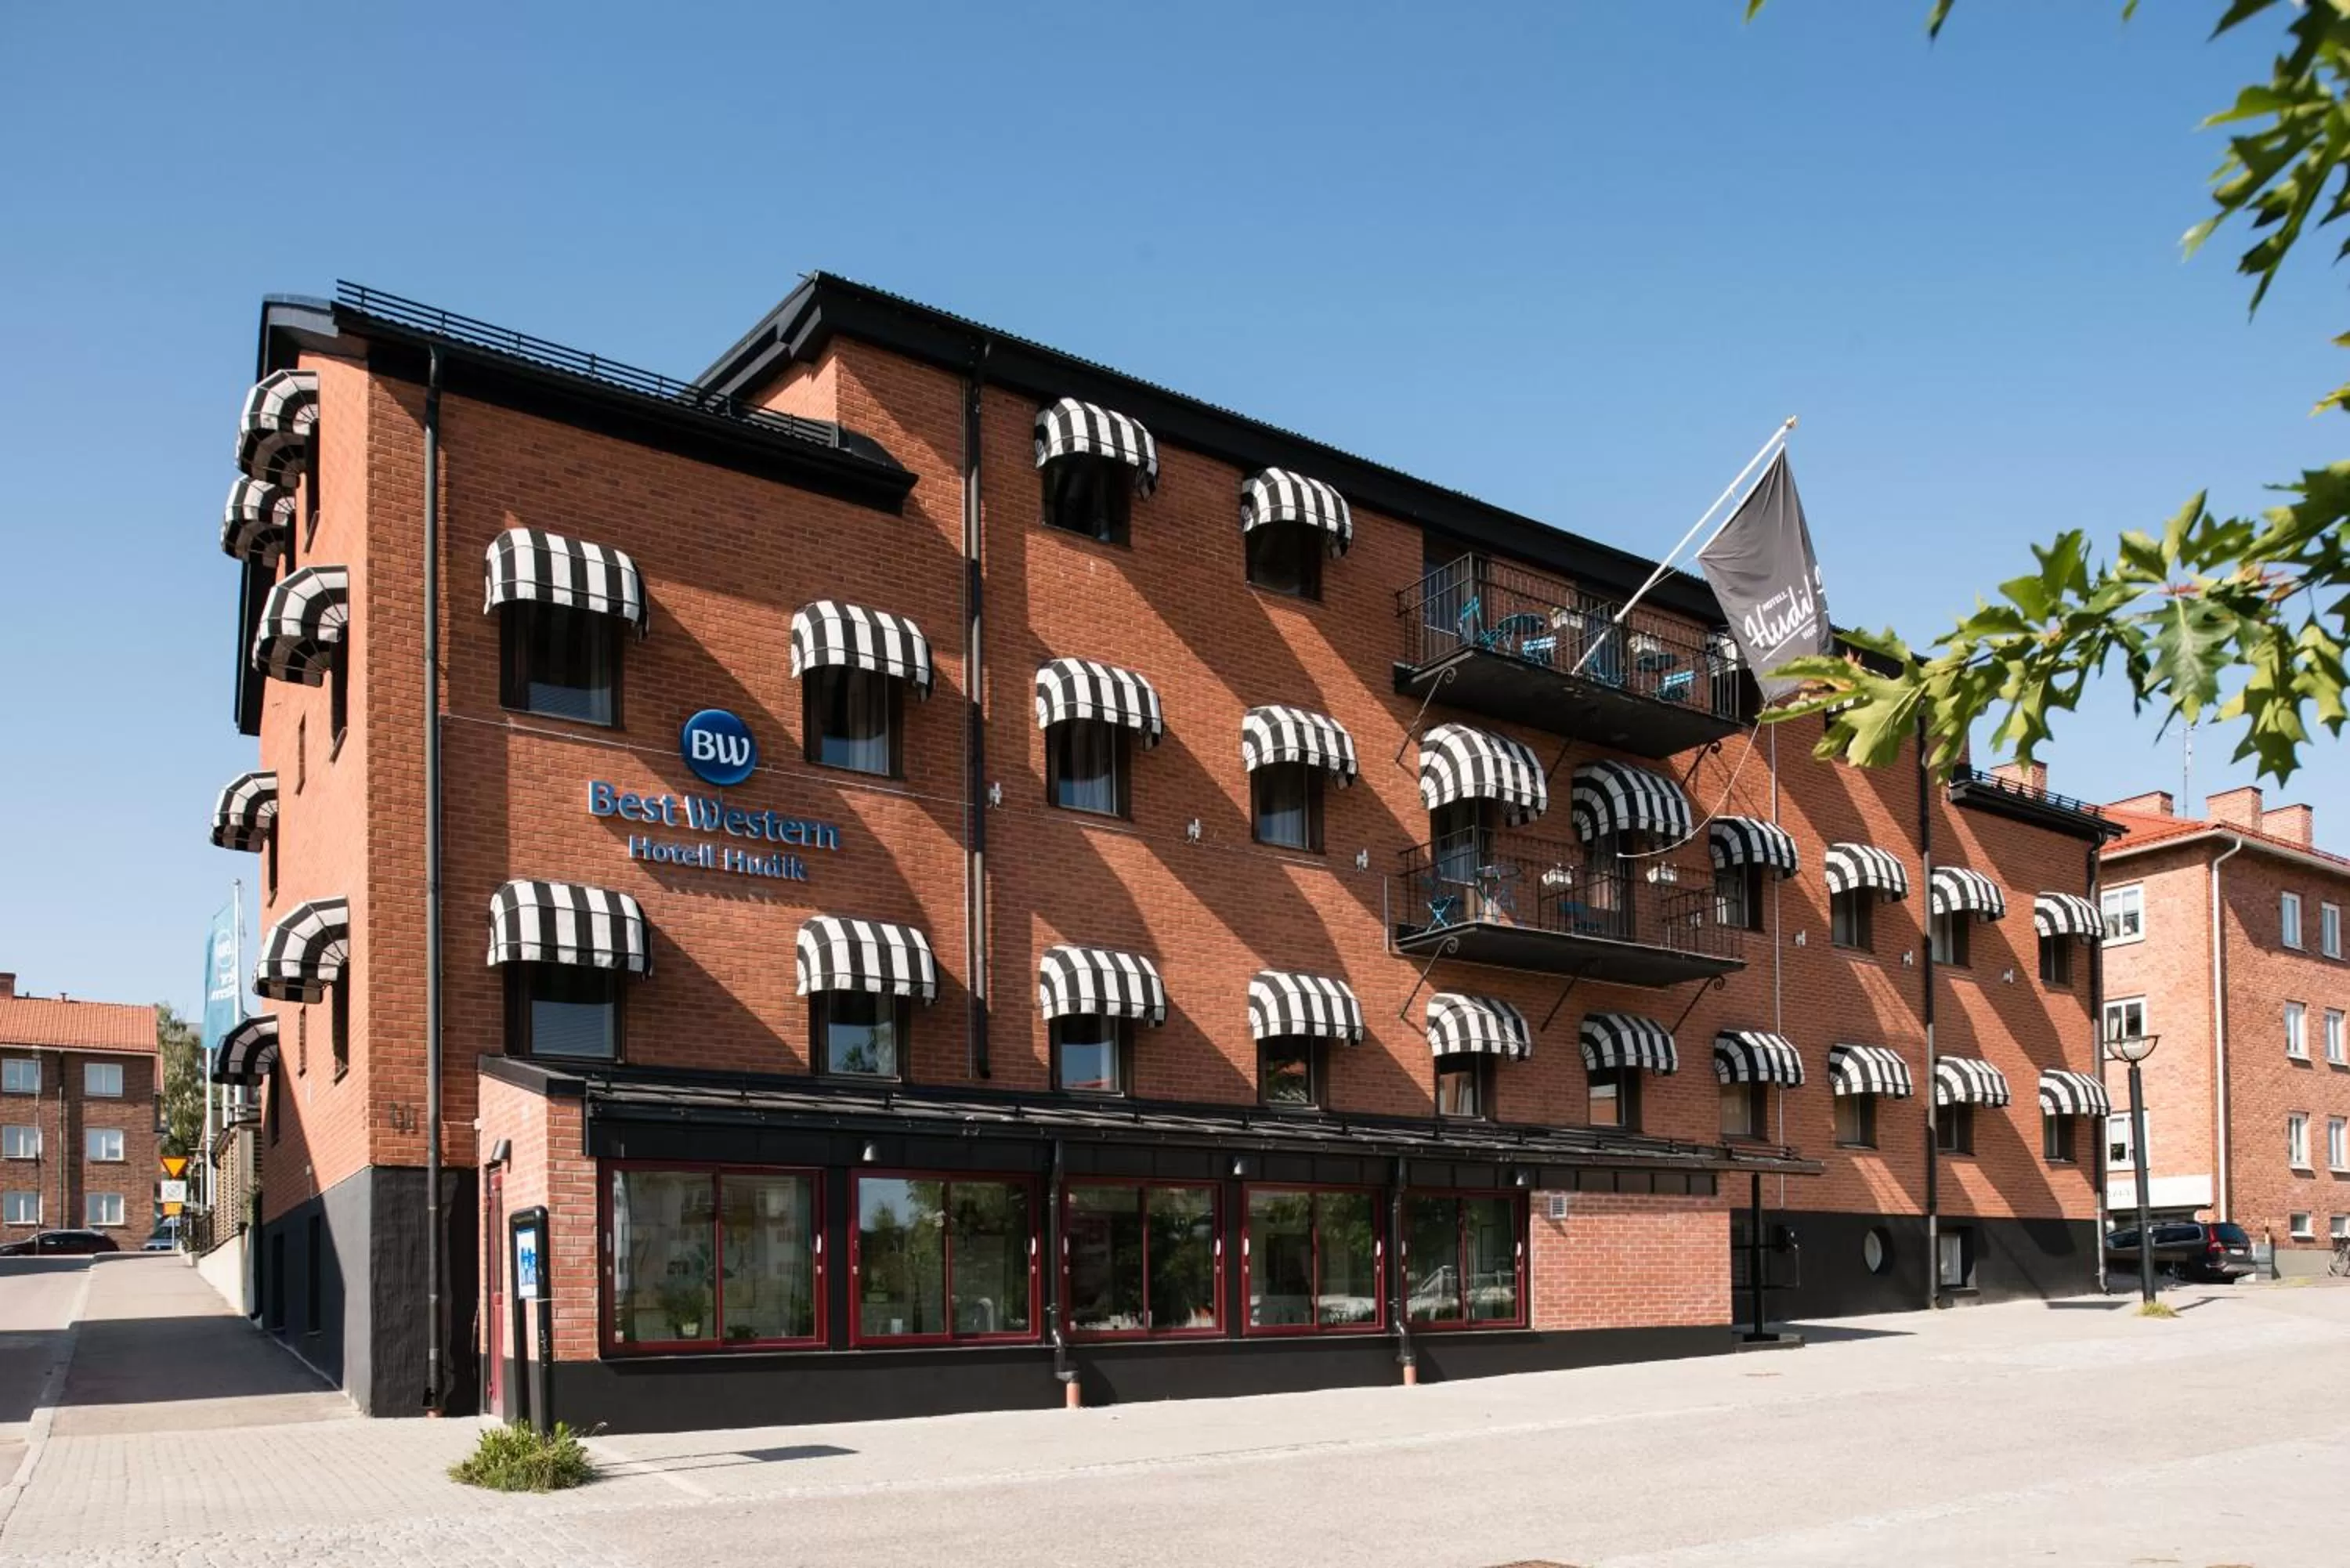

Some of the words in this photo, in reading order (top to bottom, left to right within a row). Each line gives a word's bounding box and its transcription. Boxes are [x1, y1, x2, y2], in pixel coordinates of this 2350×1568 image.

[691, 728, 750, 768] BW
[588, 780, 678, 827] Best
[684, 794, 841, 851] Western
[629, 834, 716, 869] Hotell
[724, 847, 809, 882] Hudik
